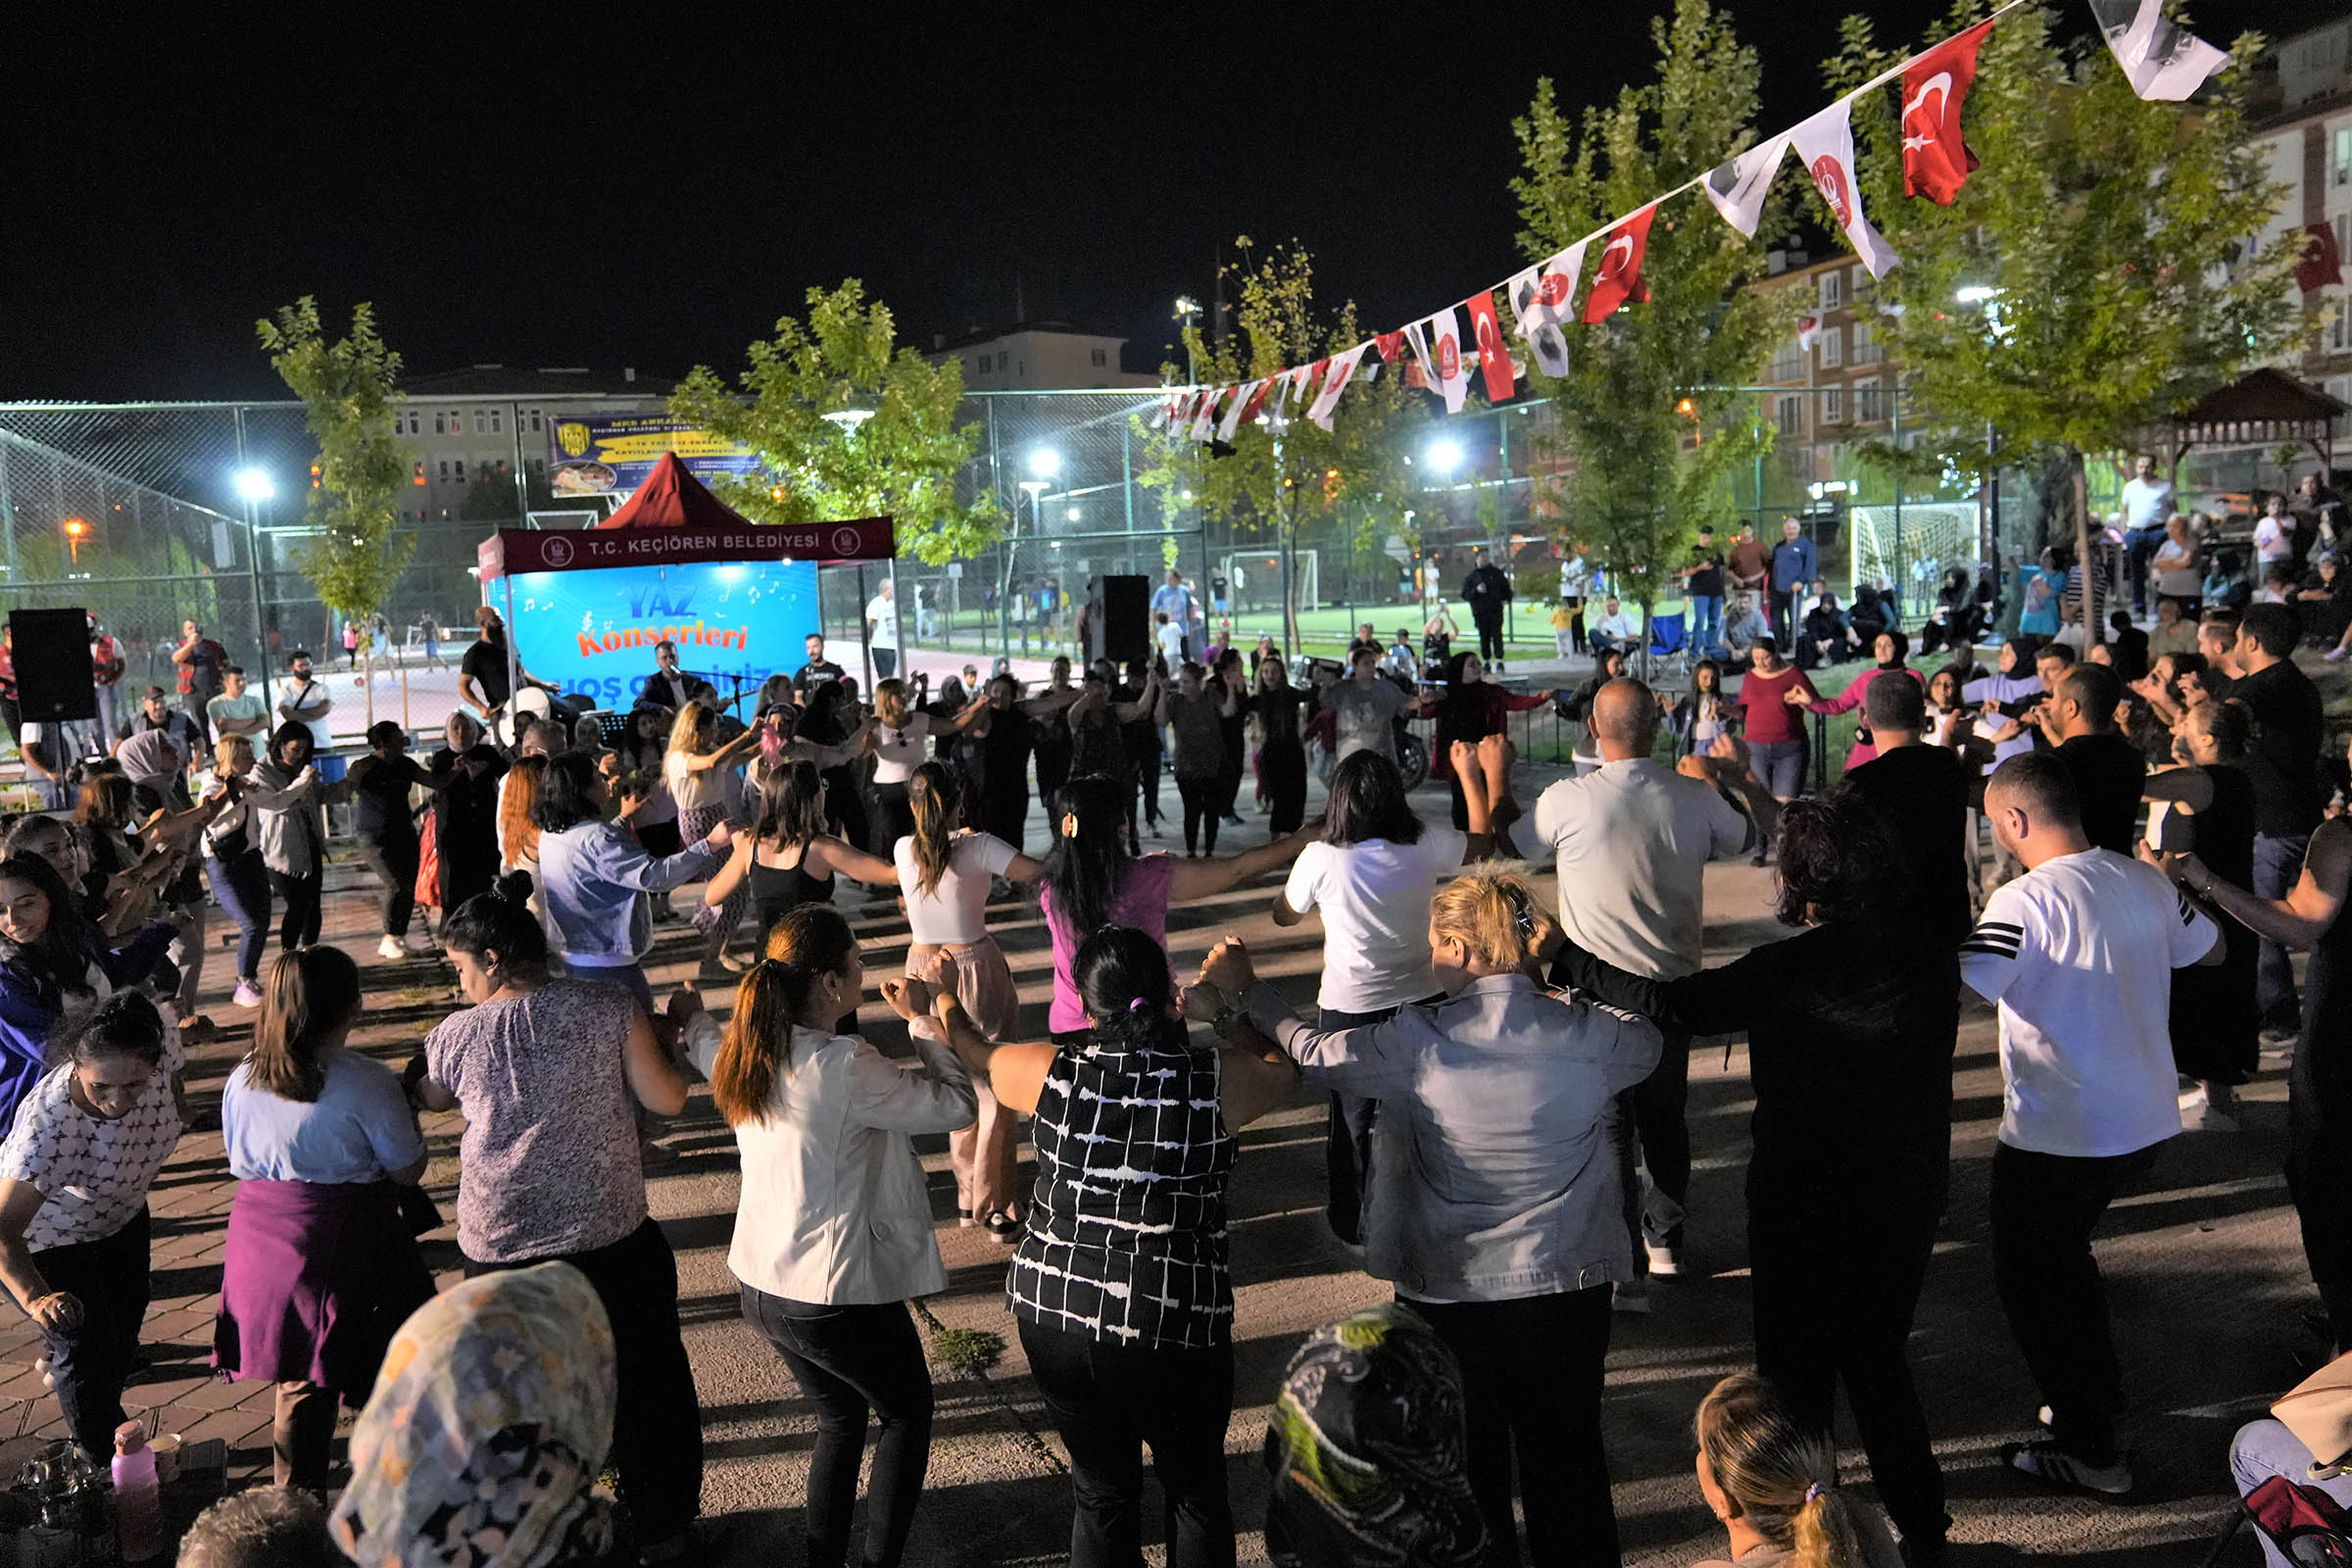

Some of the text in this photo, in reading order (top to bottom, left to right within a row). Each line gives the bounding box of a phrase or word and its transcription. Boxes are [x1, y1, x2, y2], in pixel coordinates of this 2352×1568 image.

[589, 532, 820, 556] T.C. KEÇİÖREN BELEDİYESİ
[624, 584, 699, 619] YAZ
[576, 619, 749, 659] Konserleri
